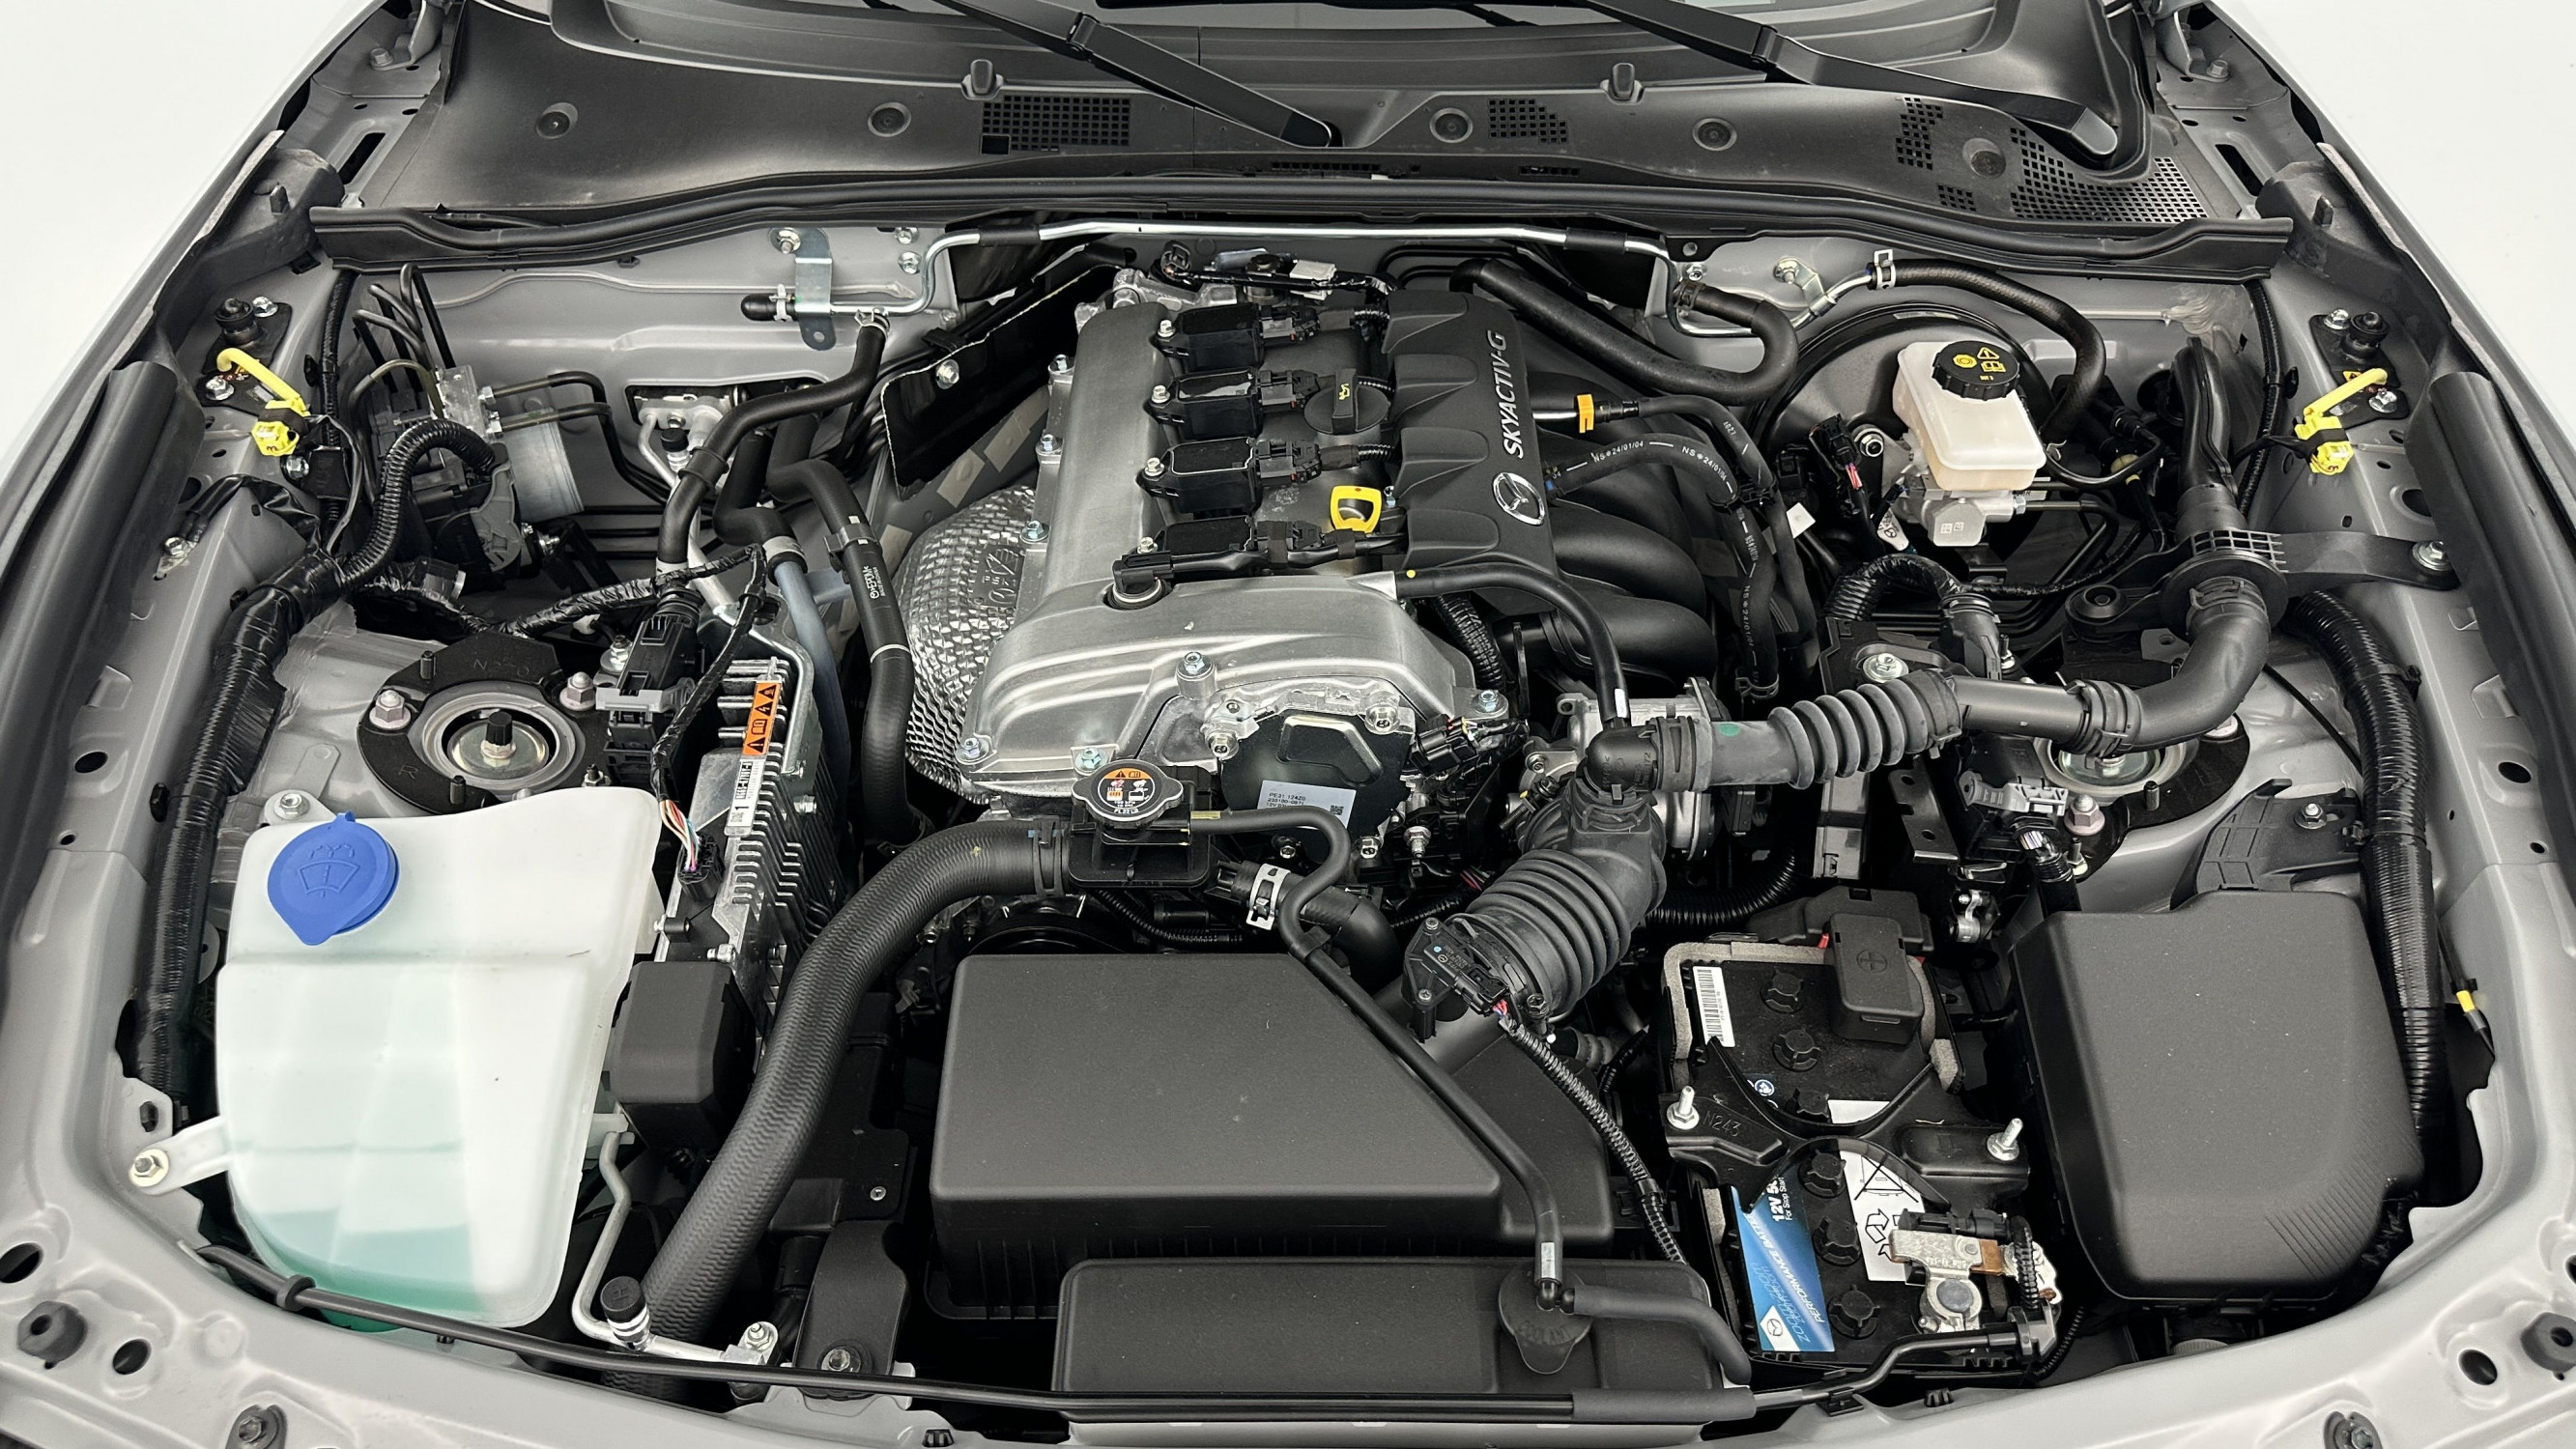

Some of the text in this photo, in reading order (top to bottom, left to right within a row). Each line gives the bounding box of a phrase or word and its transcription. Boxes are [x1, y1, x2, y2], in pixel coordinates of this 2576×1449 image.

[1487, 329, 1524, 460] SKYACTIV-G
[1703, 1110, 1742, 1137] N243
[1768, 1196, 1786, 1222] 12V
[1782, 1193, 1790, 1208] Stop
[1785, 1209, 1793, 1221] For
[1768, 1249, 1825, 1323] PERFORMANCE
